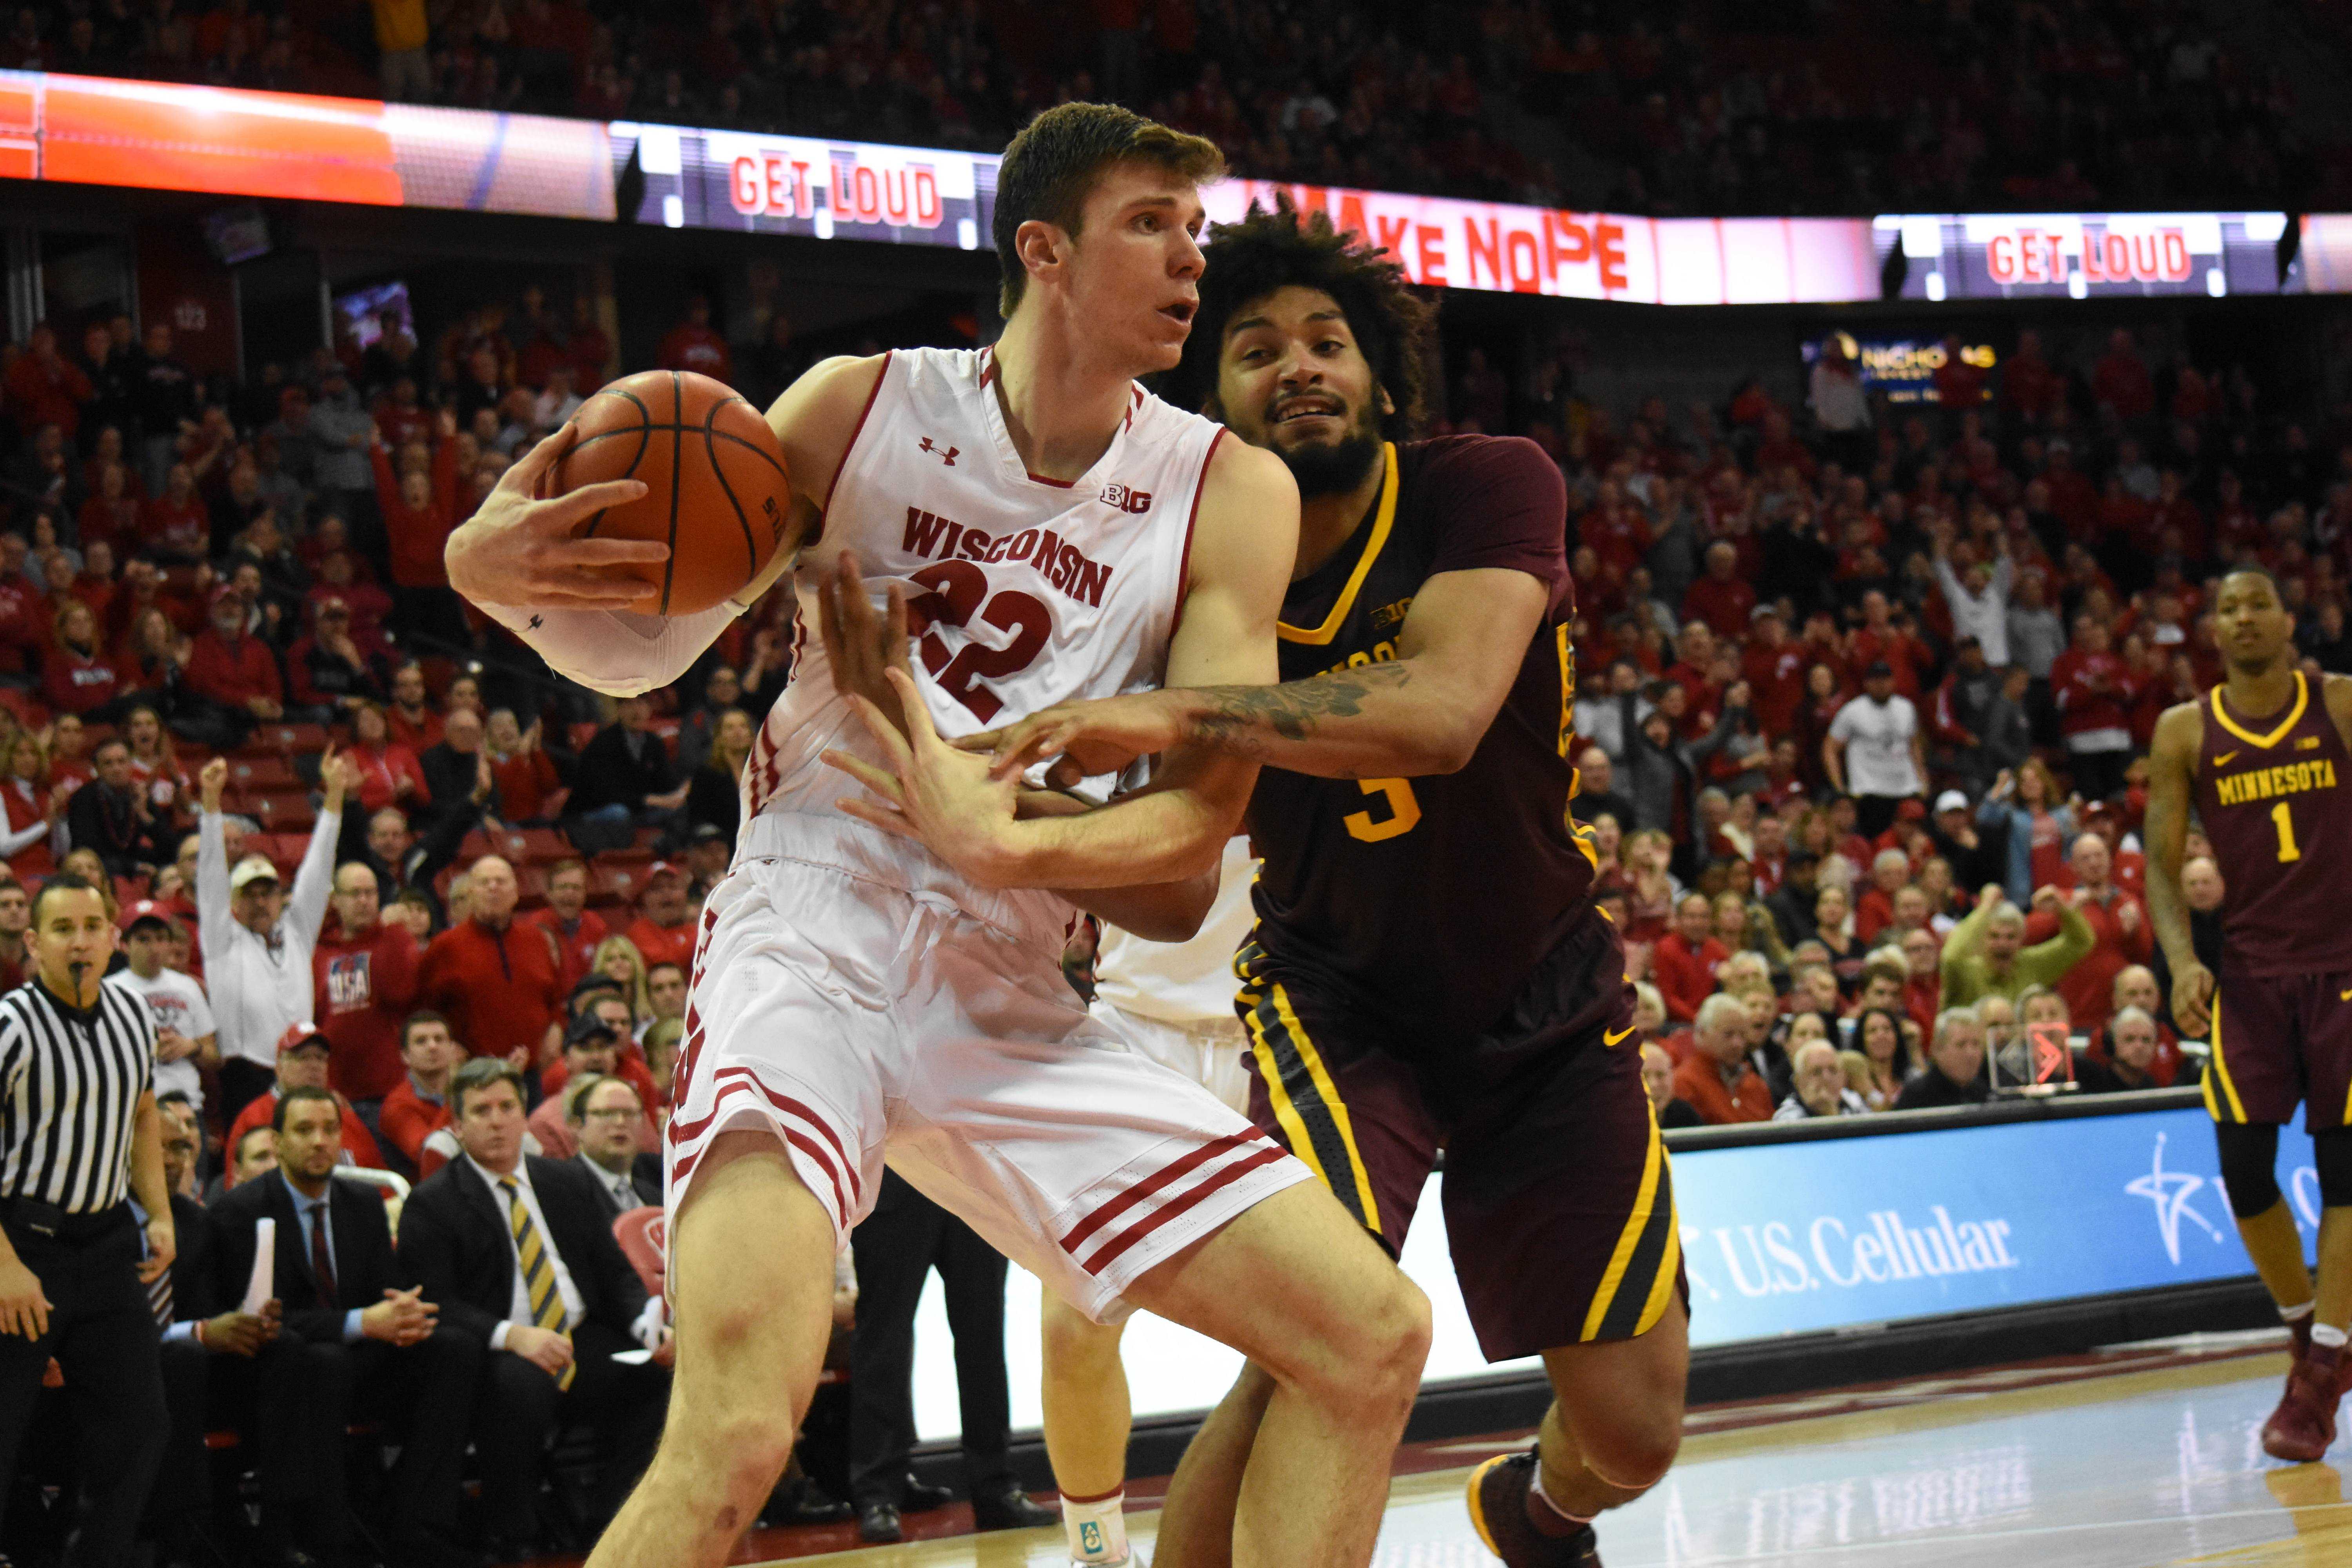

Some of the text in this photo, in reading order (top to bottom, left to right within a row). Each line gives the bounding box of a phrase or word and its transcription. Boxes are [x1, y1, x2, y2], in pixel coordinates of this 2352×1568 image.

[731, 156, 943, 227] GET LOUD
[1987, 227, 2192, 283] GET LOUD
[902, 506, 1113, 608] WISCONSIN
[906, 559, 1052, 725] 22
[2215, 758, 2336, 806] MINNESOTA
[2271, 801, 2301, 863] 1
